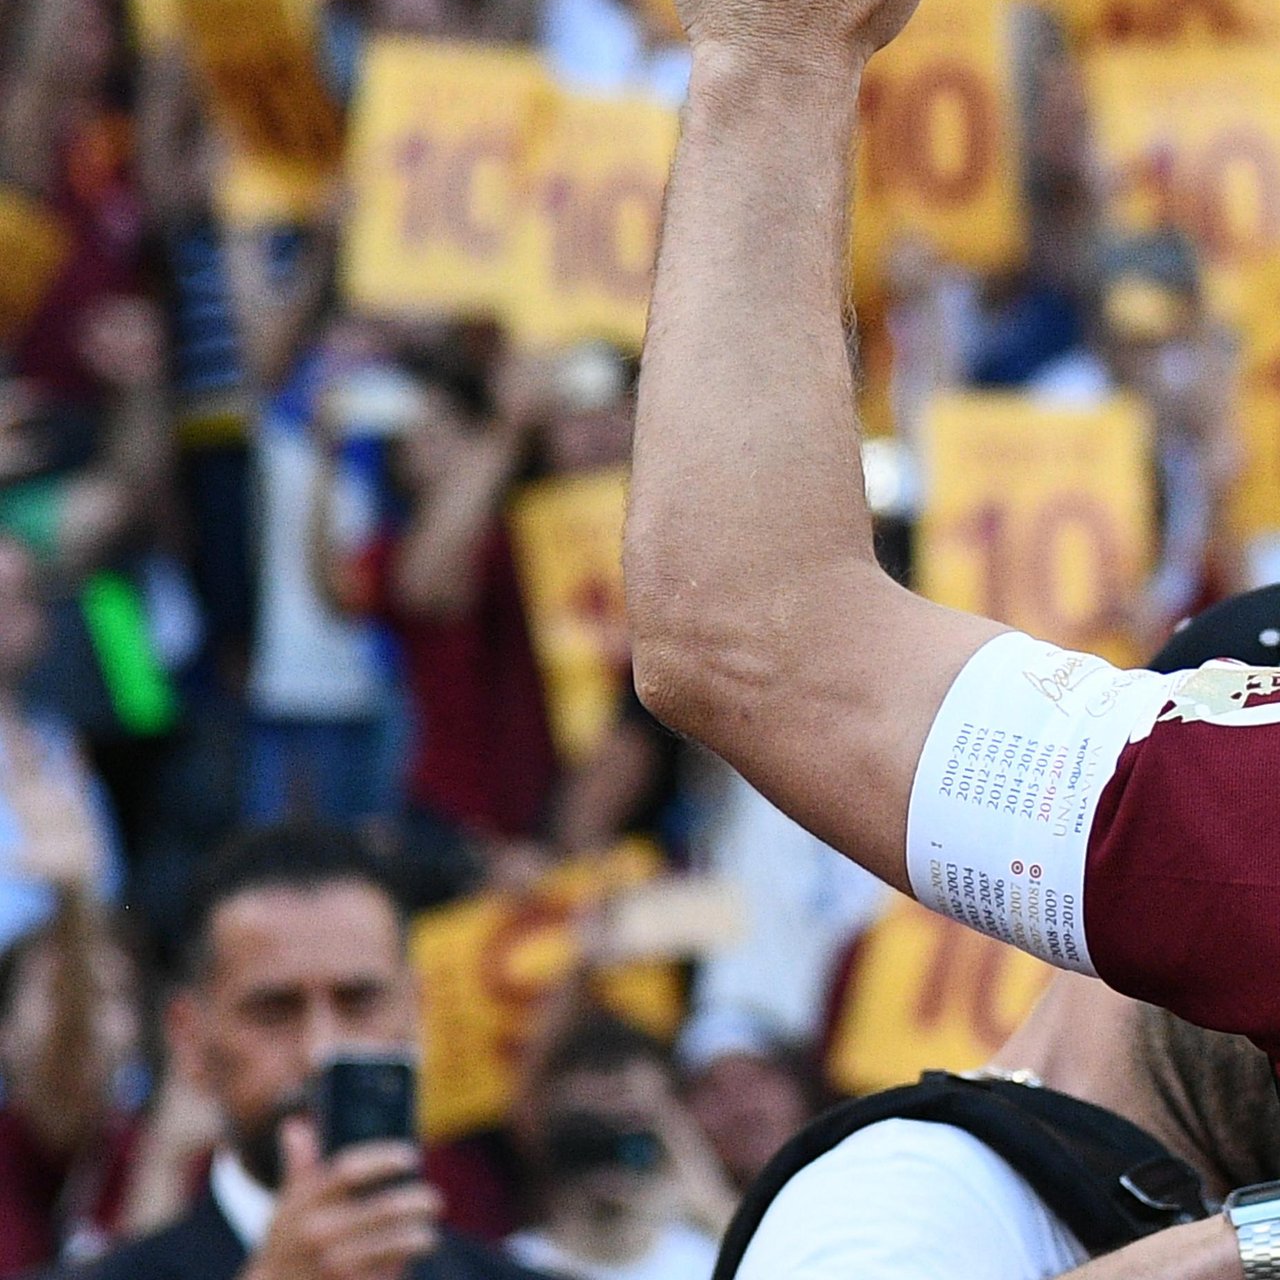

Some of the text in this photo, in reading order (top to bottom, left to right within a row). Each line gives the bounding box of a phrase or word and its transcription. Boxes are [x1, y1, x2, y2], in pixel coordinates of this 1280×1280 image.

[938, 722, 975, 797] 2010-2011
[956, 727, 990, 802] 2011-2012
[972, 729, 1007, 806] 2012-2013
[987, 733, 1023, 811] 2013-2014
[1003, 738, 1039, 815] 2014-2015
[1020, 743, 1055, 819] 2015-2016
[1037, 744, 1070, 823] 2016-2017
[1052, 736, 1091, 837] UNA SQUADRA
[1074, 745, 1103, 834] PER LA VITA
